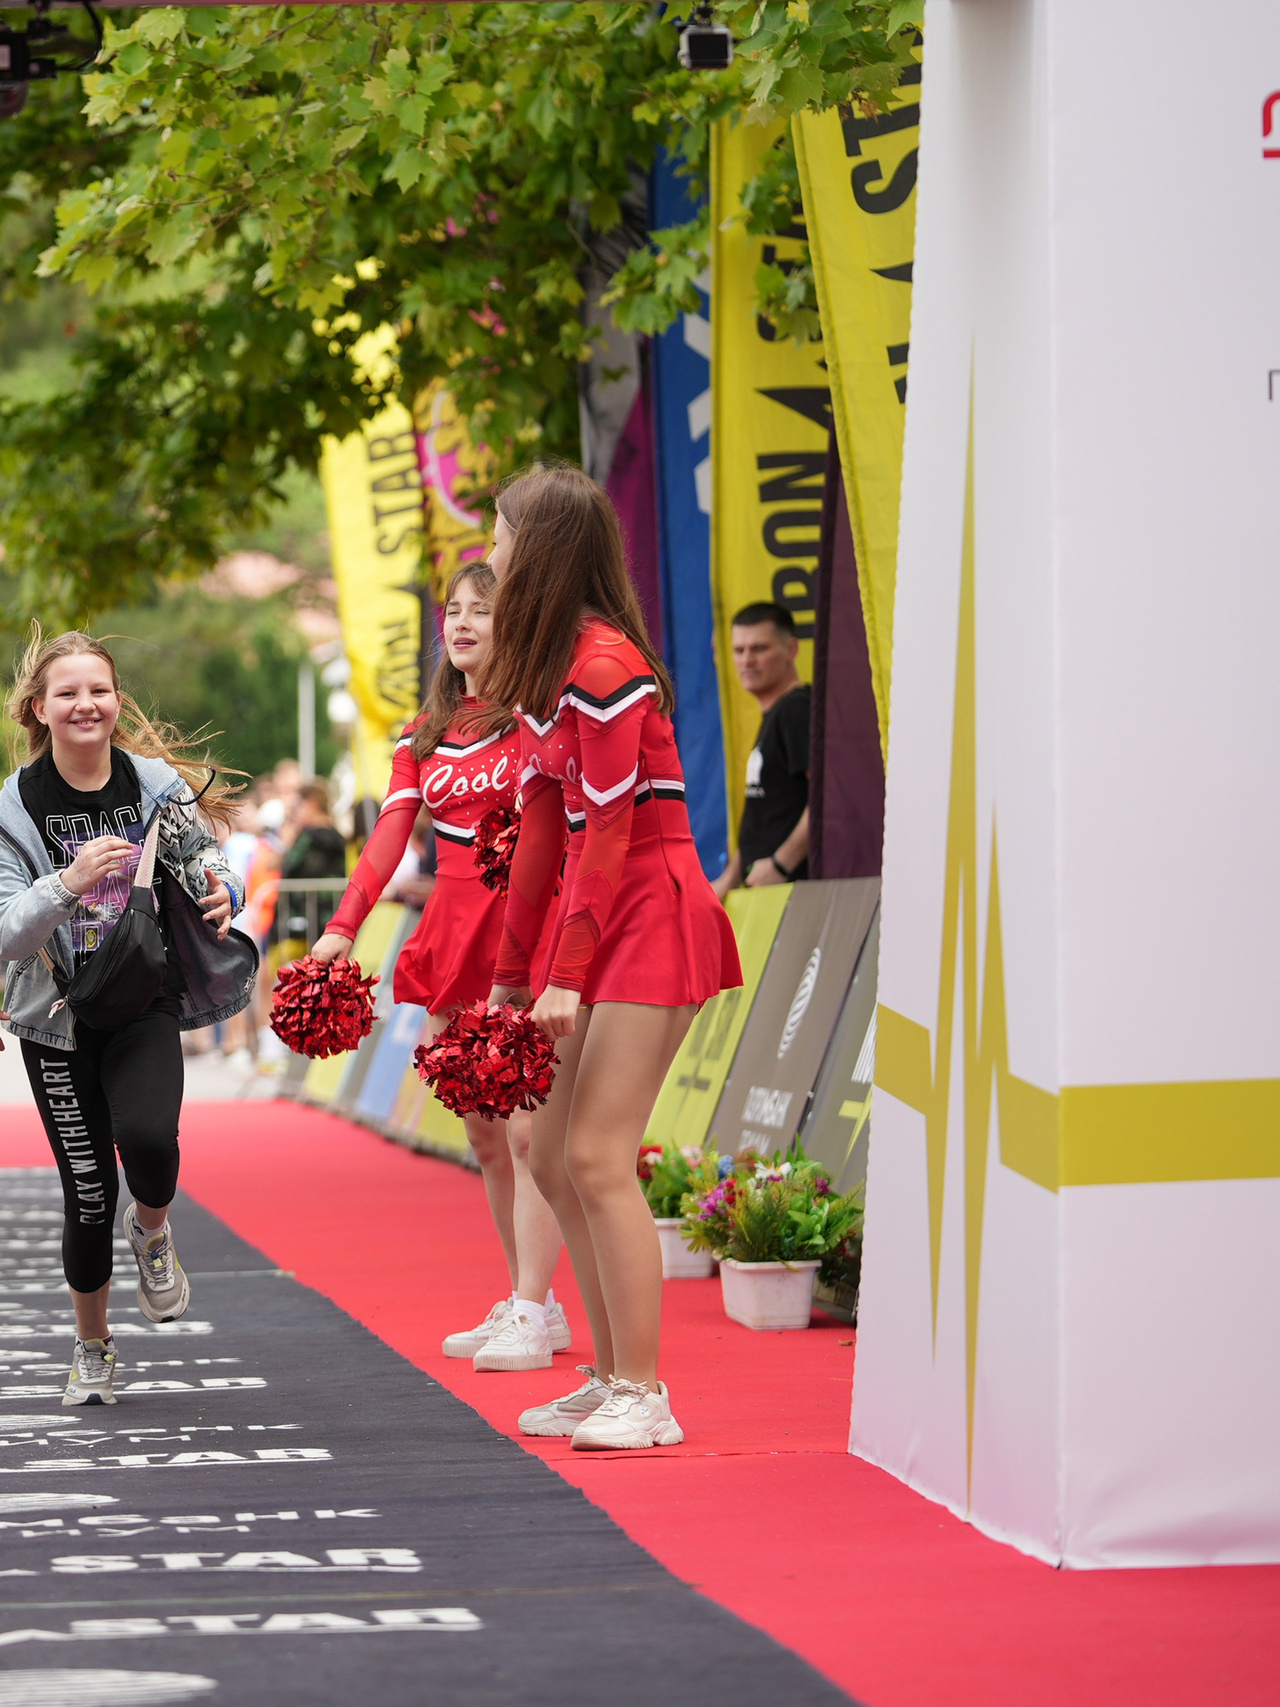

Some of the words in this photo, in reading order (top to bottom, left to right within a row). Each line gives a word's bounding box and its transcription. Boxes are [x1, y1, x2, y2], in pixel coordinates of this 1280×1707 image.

[422, 764, 510, 809] Cool
[46, 802, 142, 869] SPAC
[39, 1058, 84, 1122] HEART
[57, 1124, 98, 1175] WITH
[75, 1179, 106, 1225] PLAY
[0, 1377, 267, 1395] SAR
[24, 1447, 334, 1470] STAR
[51, 1547, 422, 1573] STAR
[70, 1607, 480, 1636] STAR
